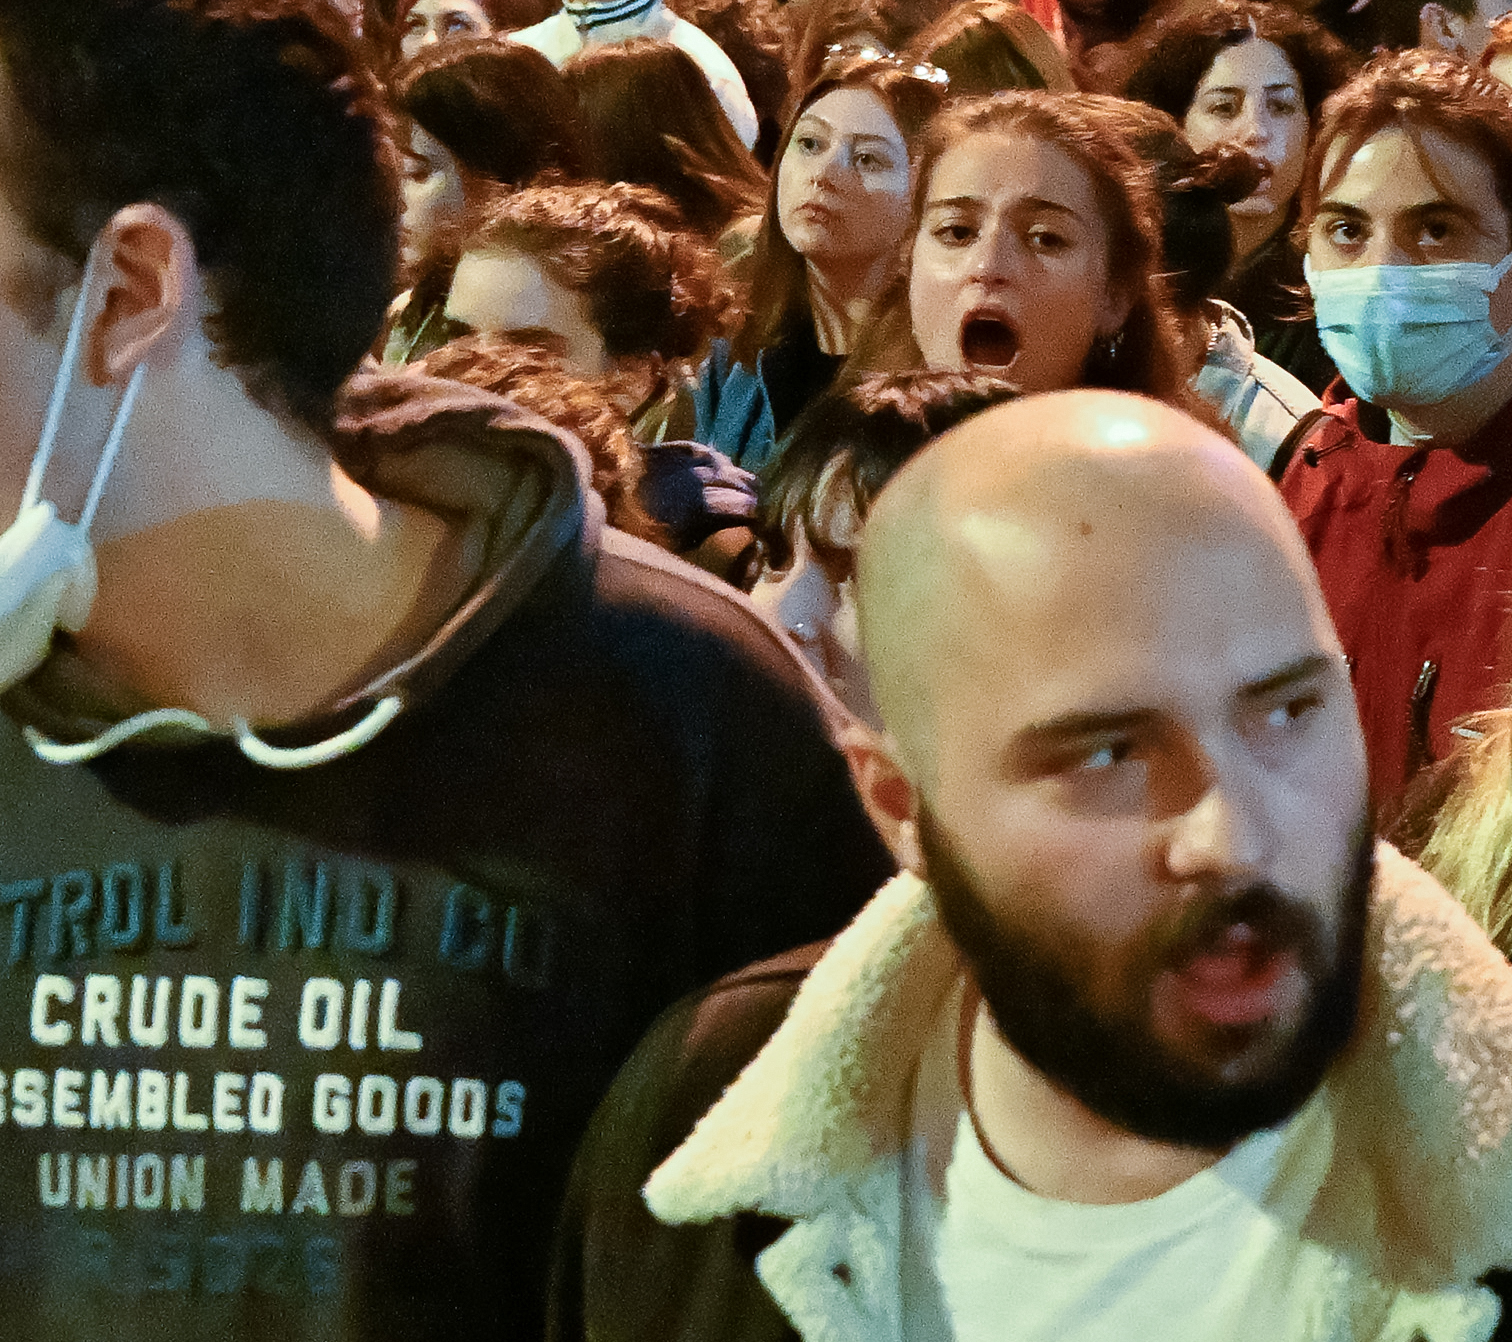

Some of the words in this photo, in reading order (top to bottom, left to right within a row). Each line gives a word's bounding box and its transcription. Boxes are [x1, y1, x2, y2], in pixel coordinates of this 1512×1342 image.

[237, 857, 394, 952] IND
[29, 973, 271, 1050] CRUDE
[297, 976, 425, 1053] OIL
[311, 1072, 528, 1140] GOODS
[37, 1152, 206, 1212] UNION
[239, 1156, 419, 1218] MADE
